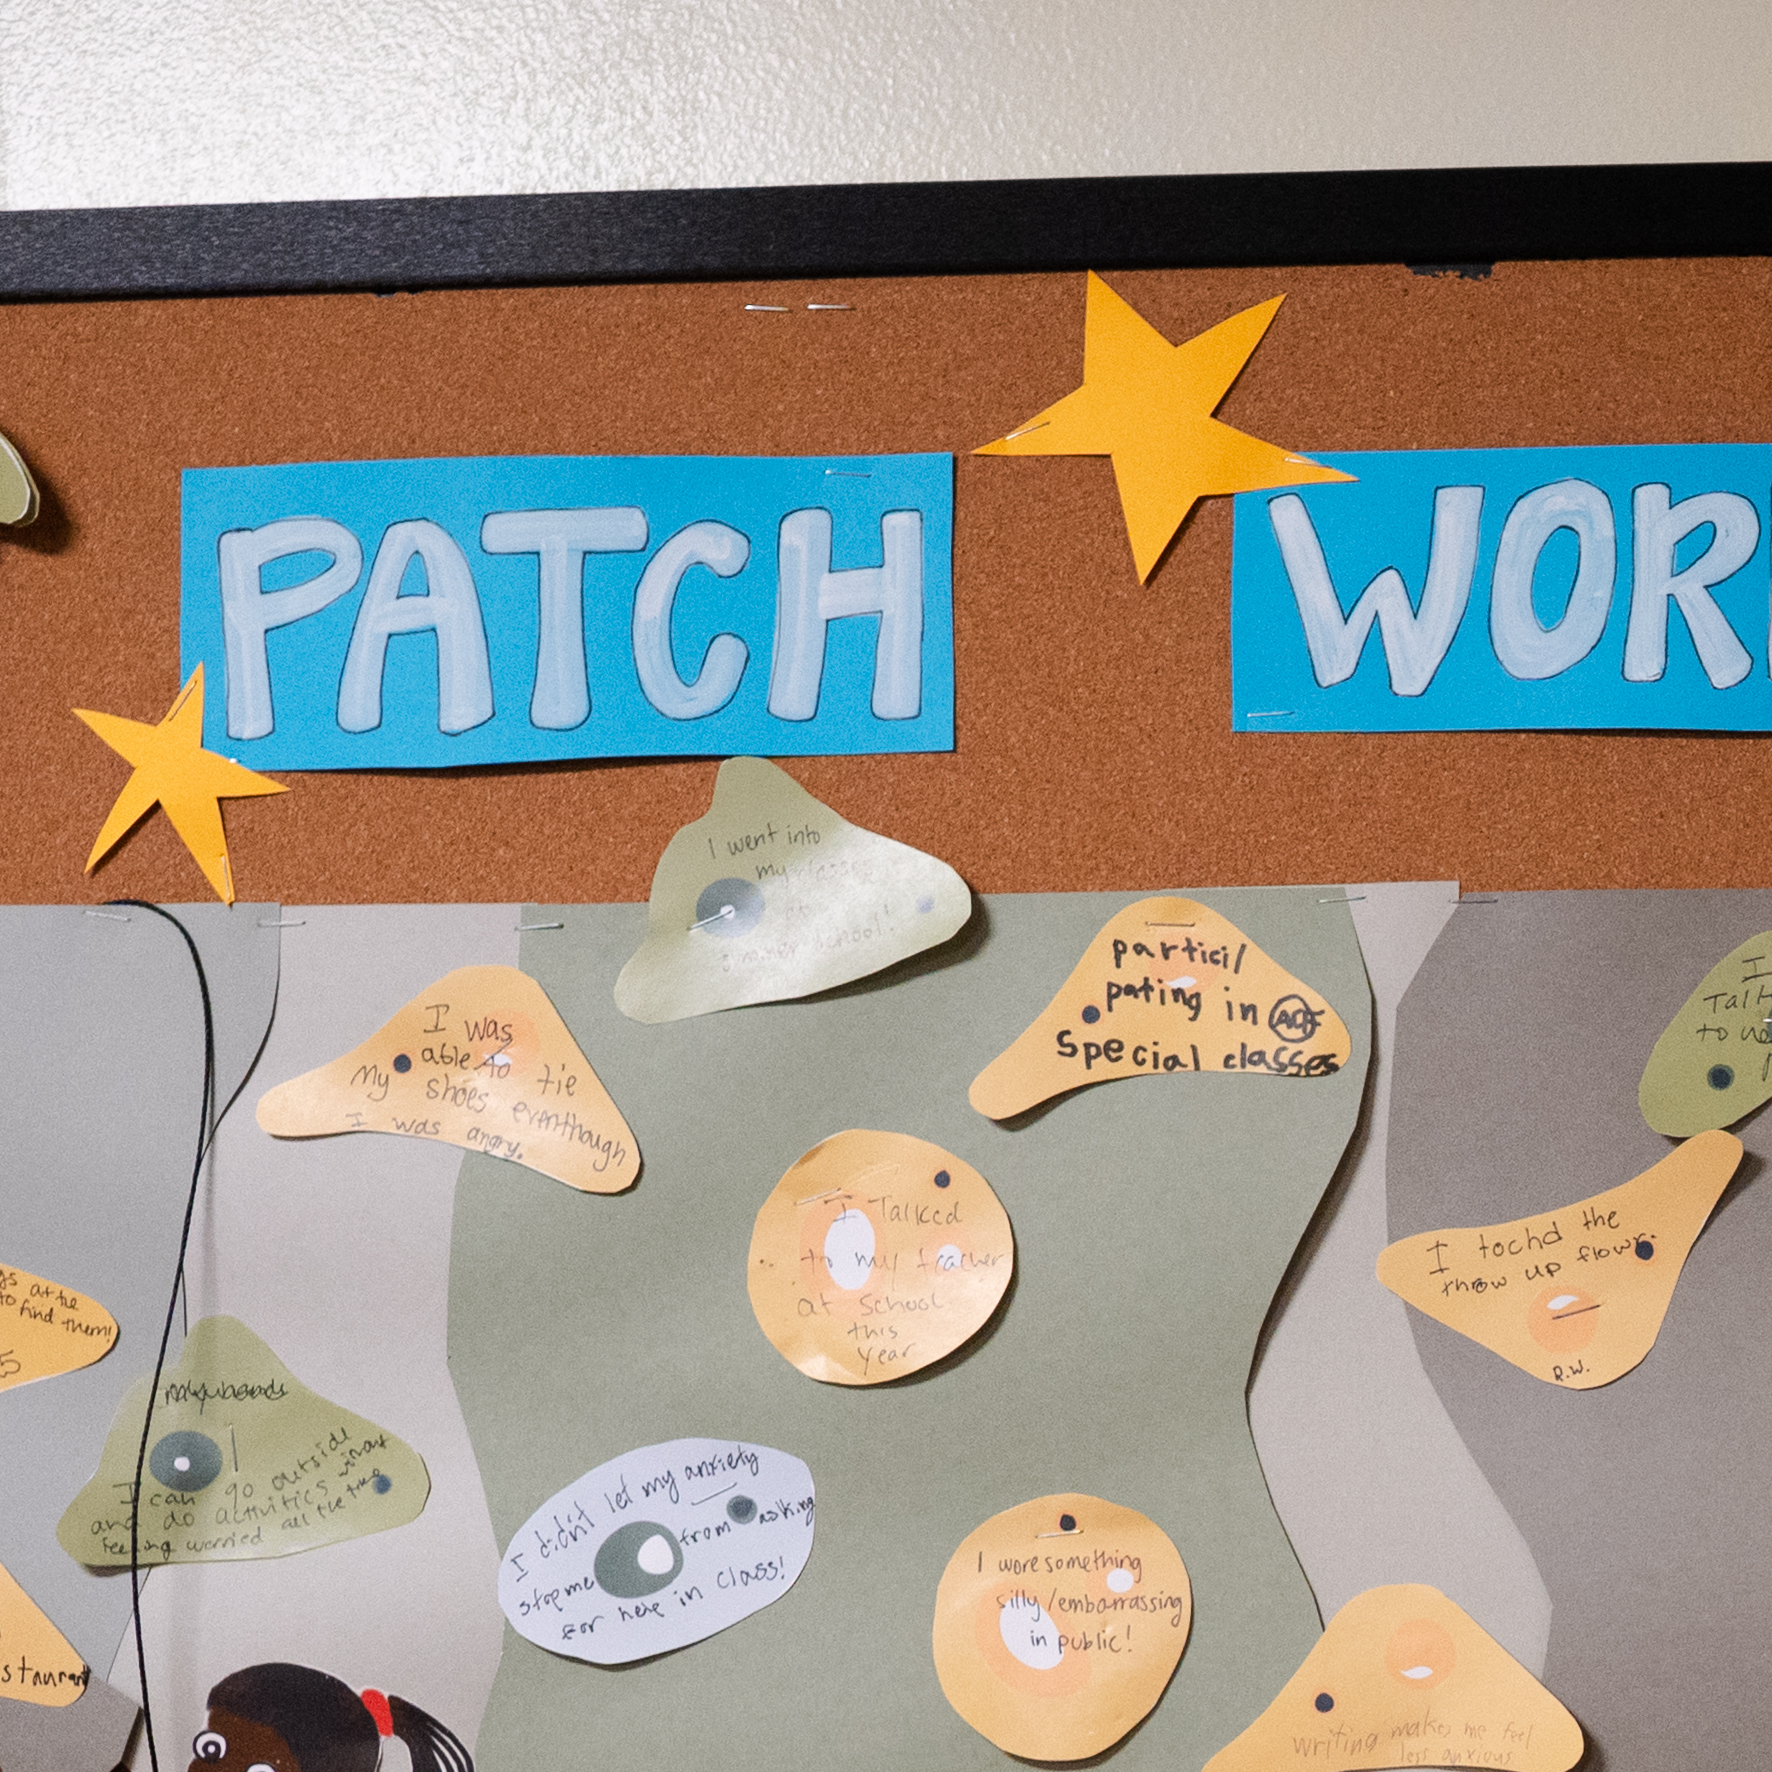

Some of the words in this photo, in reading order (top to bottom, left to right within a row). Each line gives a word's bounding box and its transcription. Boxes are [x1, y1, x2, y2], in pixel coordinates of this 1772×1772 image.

[217, 506, 924, 741] PATCH
[728, 822, 780, 857] went
[786, 822, 821, 845] into
[1105, 975, 1204, 1022] pating
[1223, 985, 1260, 1026] in
[422, 1002, 451, 1034] I
[464, 1019, 514, 1042] was
[1695, 1023, 1730, 1043] to
[420, 1042, 472, 1072] able
[537, 1063, 578, 1098] tie
[1223, 1044, 1342, 1078] classes
[426, 1076, 491, 1114] shoes
[391, 1116, 443, 1137] was
[1425, 1239, 1450, 1275] I
[1477, 1220, 1564, 1259] tochd
[1581, 1205, 1621, 1230] the
[1440, 1278, 1508, 1297] throw
[1523, 1262, 1562, 1281] up
[846, 1320, 900, 1342] this
[602, 1473, 634, 1514] let
[641, 1467, 680, 1505] my
[684, 1443, 760, 1481] anxiety
[518, 1587, 564, 1617] stop
[680, 1520, 732, 1547] from
[757, 1494, 816, 1529] asking
[998, 1555, 1039, 1576] wore
[1041, 1549, 1143, 1584] something
[674, 1589, 704, 1608] in
[995, 1588, 1042, 1623] silly
[1029, 1629, 1048, 1648] in
[1057, 1623, 1133, 1656] public!
